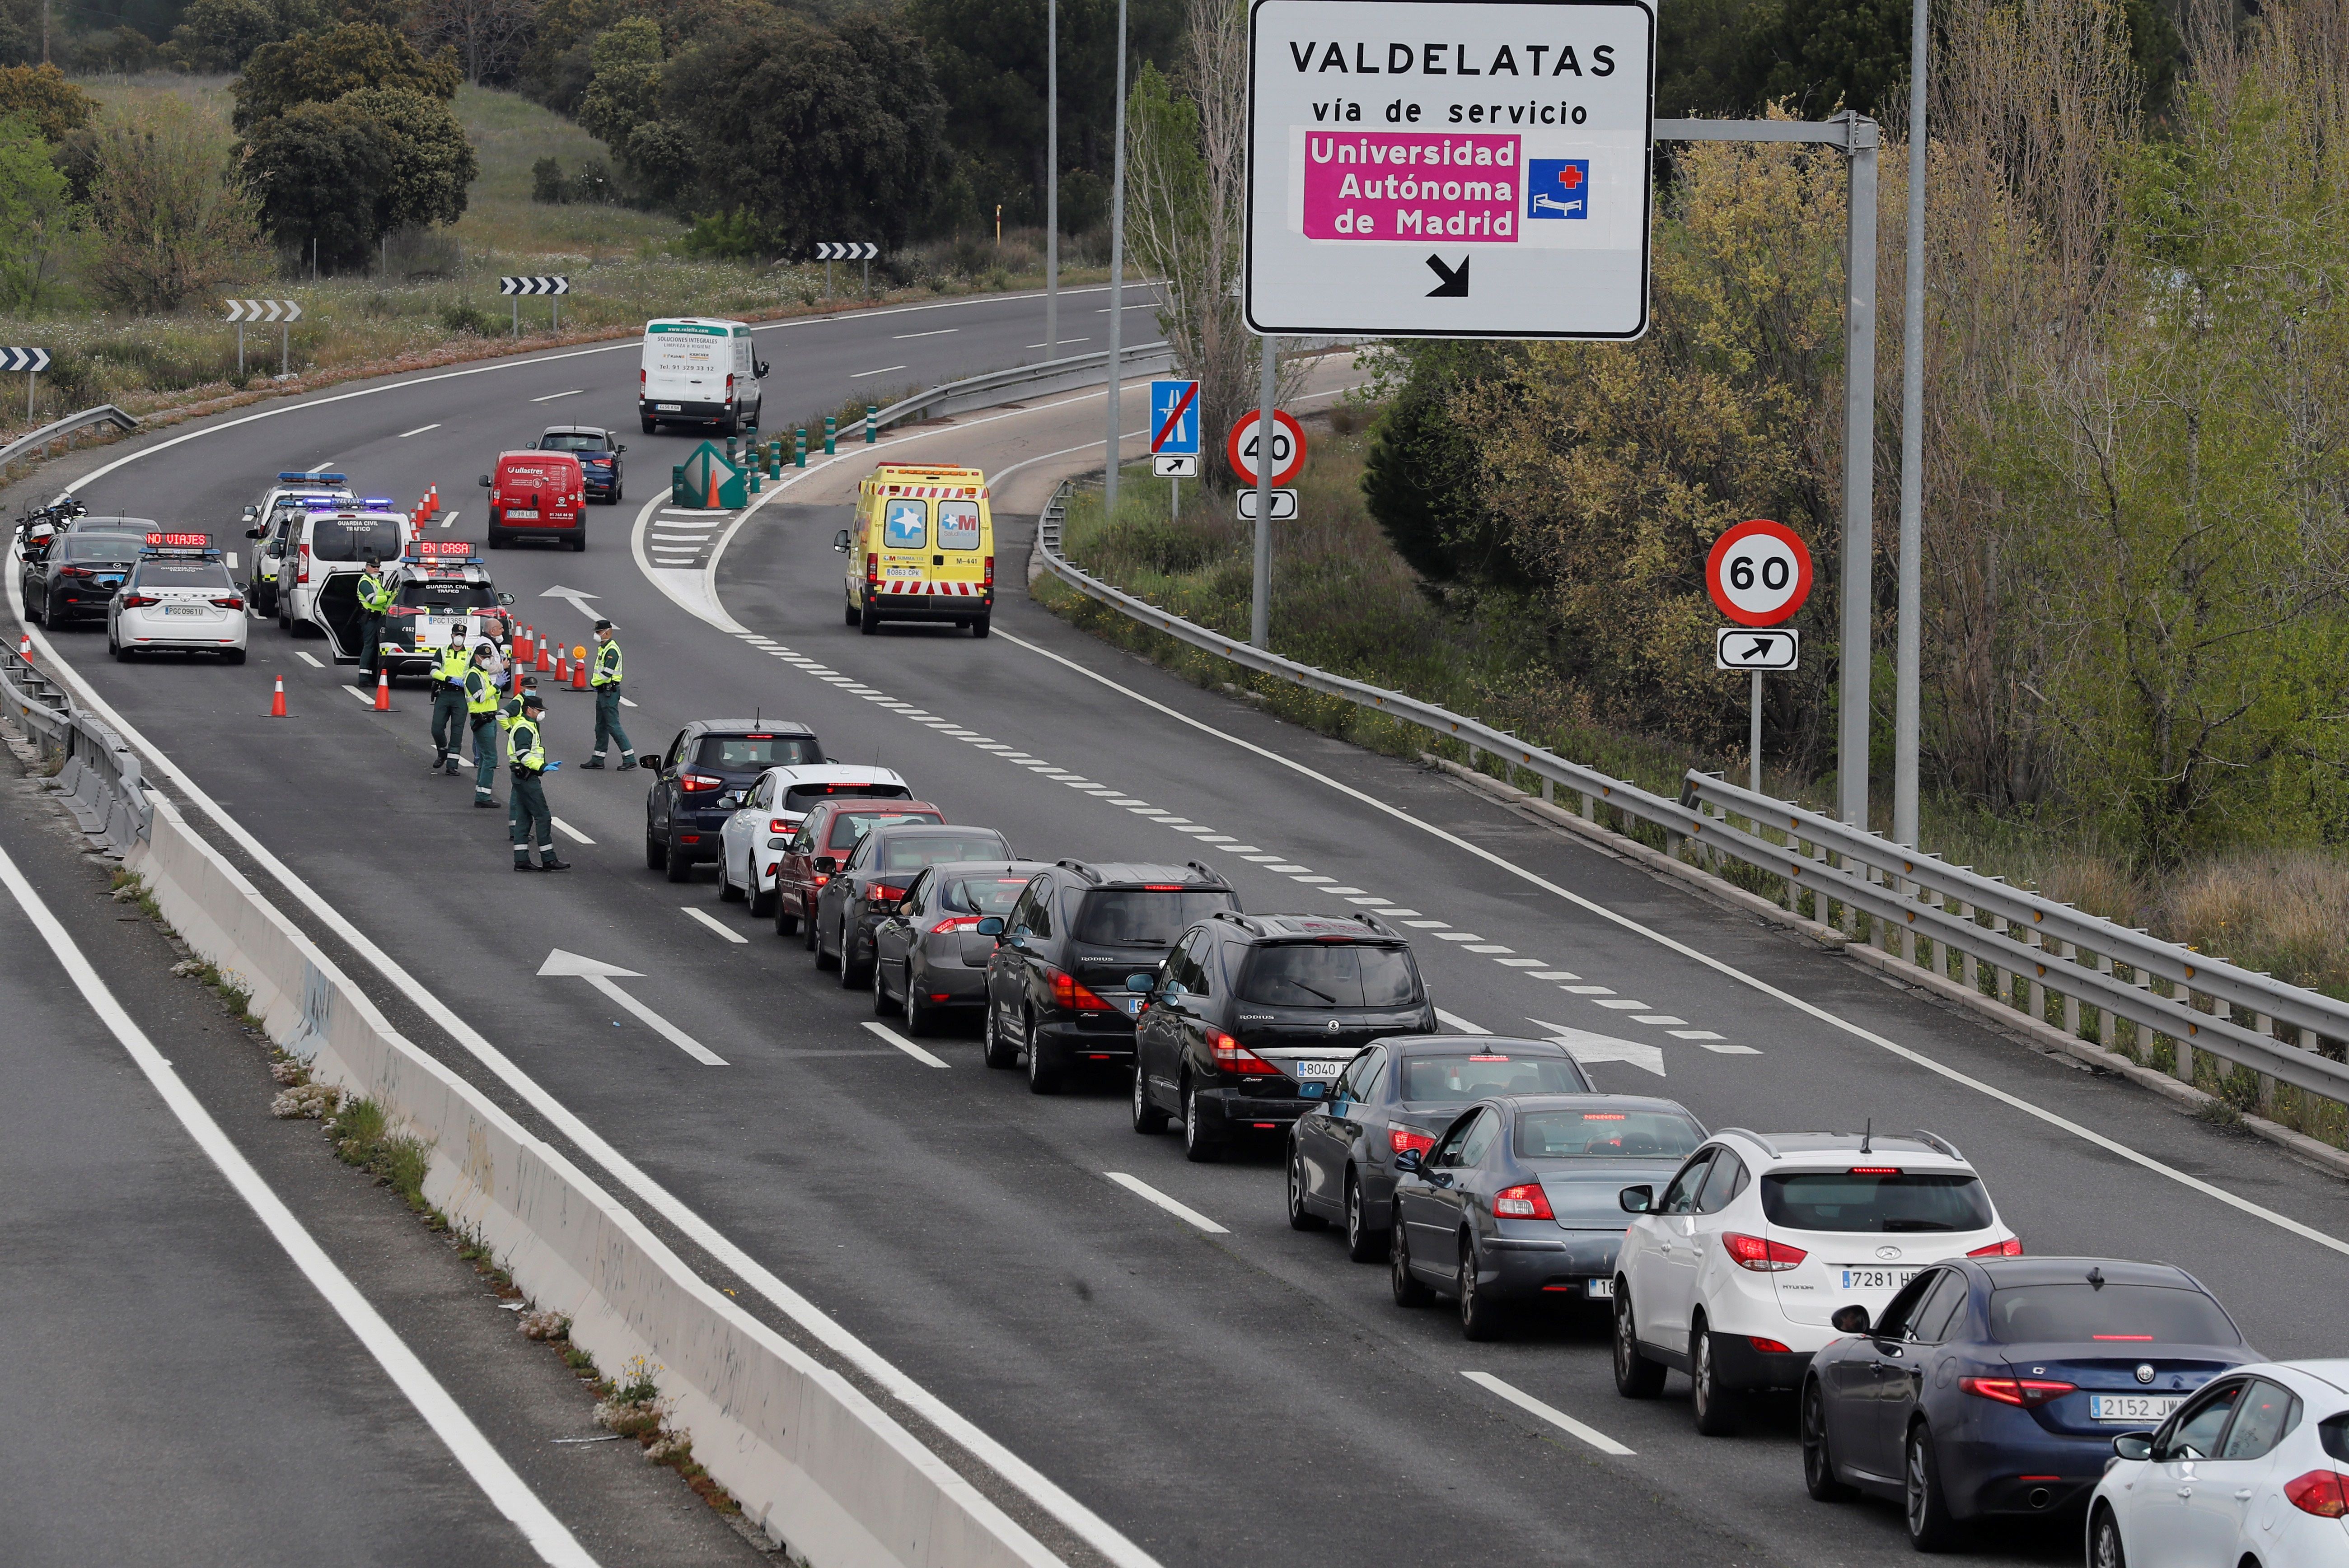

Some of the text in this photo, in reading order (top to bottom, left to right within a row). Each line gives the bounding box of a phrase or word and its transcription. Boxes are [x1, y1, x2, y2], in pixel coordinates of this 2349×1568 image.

[1289, 41, 1616, 77] VALDELATAS
[1312, 98, 1588, 124] vía de servicio
[1311, 137, 1515, 167] Universidad
[1338, 173, 1513, 201] Autónoma
[1334, 208, 1513, 236] de Madrid
[1244, 435, 1290, 461] 40
[959, 515, 976, 531] M
[147, 534, 206, 545] NO VIAJES
[422, 542, 469, 554] EN CASA
[1730, 556, 1789, 590] 60
[1307, 1064, 1335, 1075] 8040
[1853, 1272, 1892, 1286] 7281
[2104, 1400, 2149, 1416] 2152
[2157, 1400, 2183, 1416] JW
